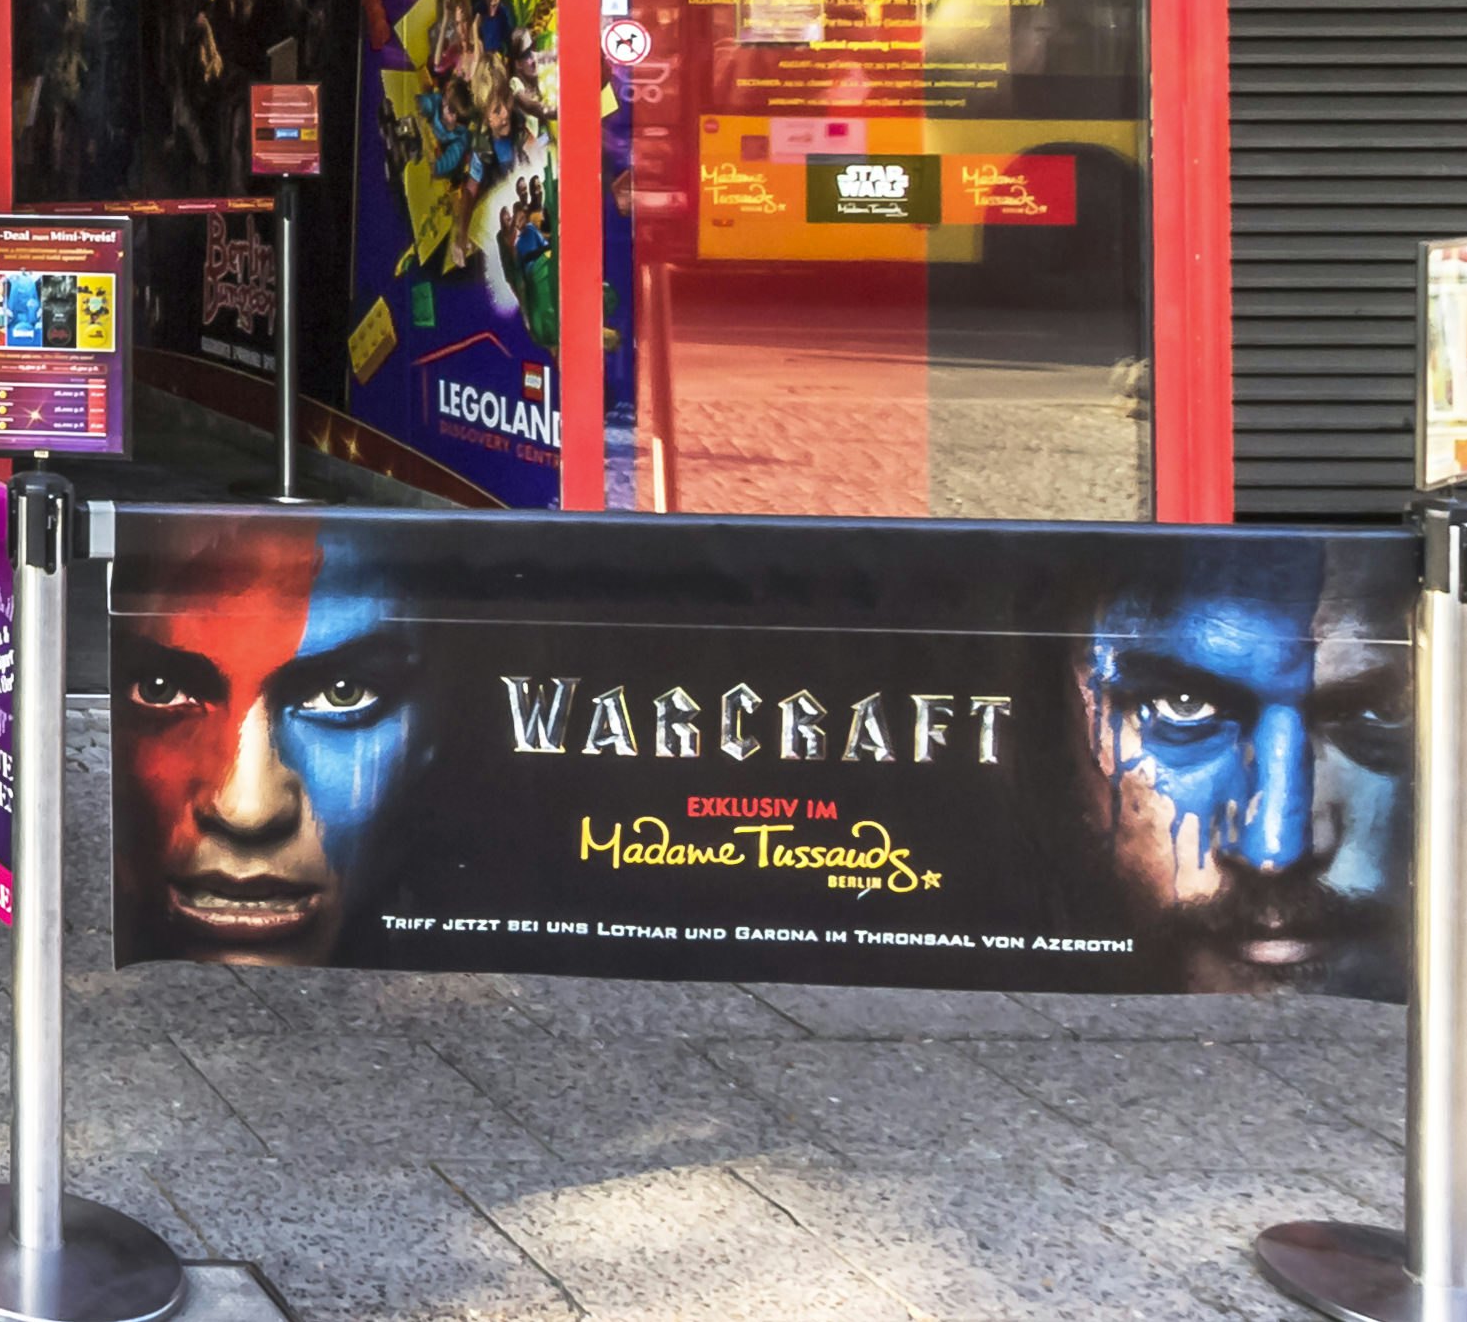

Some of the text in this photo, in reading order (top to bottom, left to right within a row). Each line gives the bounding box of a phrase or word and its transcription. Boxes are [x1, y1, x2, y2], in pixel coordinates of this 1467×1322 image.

[837, 165, 909, 182] STAR
[837, 179, 909, 197] WARS
[51, 231, 116, 243] Mini-Preis!
[205, 212, 275, 284] Berlin
[439, 420, 510, 453] DISCOVERY
[500, 675, 1012, 764] WARCRAFT
[687, 796, 838, 820] EXKLUSIV IM
[580, 816, 918, 893] Madame Tussauds
[828, 875, 881, 889] BERLIN
[442, 919, 501, 931] JETZT
[507, 920, 539, 933] BEI
[546, 921, 589, 934] UNS
[685, 928, 726, 940] UND
[825, 931, 847, 943] IM
[981, 936, 1024, 950] VON
